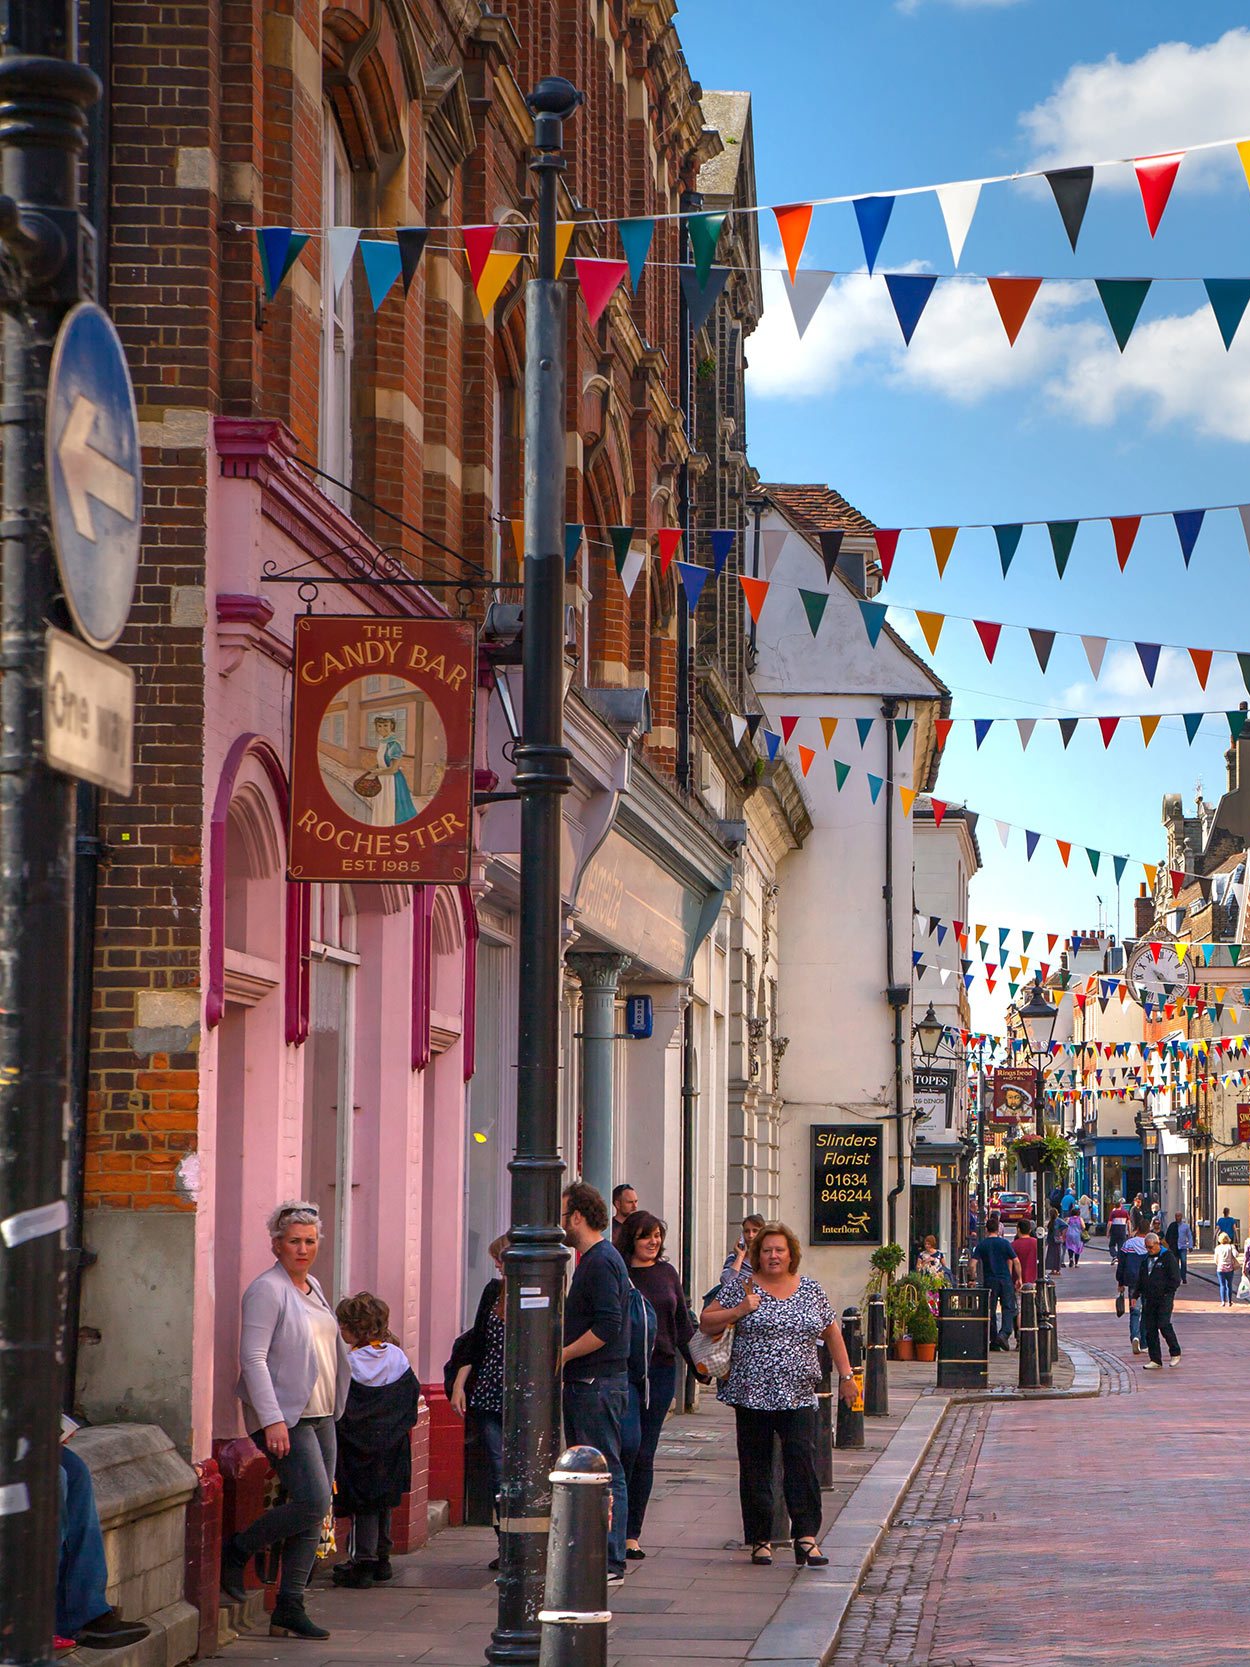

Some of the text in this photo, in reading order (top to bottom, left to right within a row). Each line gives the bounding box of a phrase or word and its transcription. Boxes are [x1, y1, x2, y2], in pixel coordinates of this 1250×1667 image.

[363, 625, 403, 639] THE
[301, 640, 468, 692] CANDY BAR
[50, 671, 89, 740] One
[297, 808, 466, 855] ROCHESTER
[342, 860, 420, 872] EST. 1985
[914, 1074, 948, 1086] TOPES
[816, 1133, 878, 1147] Slinders
[823, 1152, 871, 1165] Florist
[825, 1173, 868, 1186] 01634
[821, 1189, 873, 1202] 846244
[822, 1225, 860, 1234] Interflora
